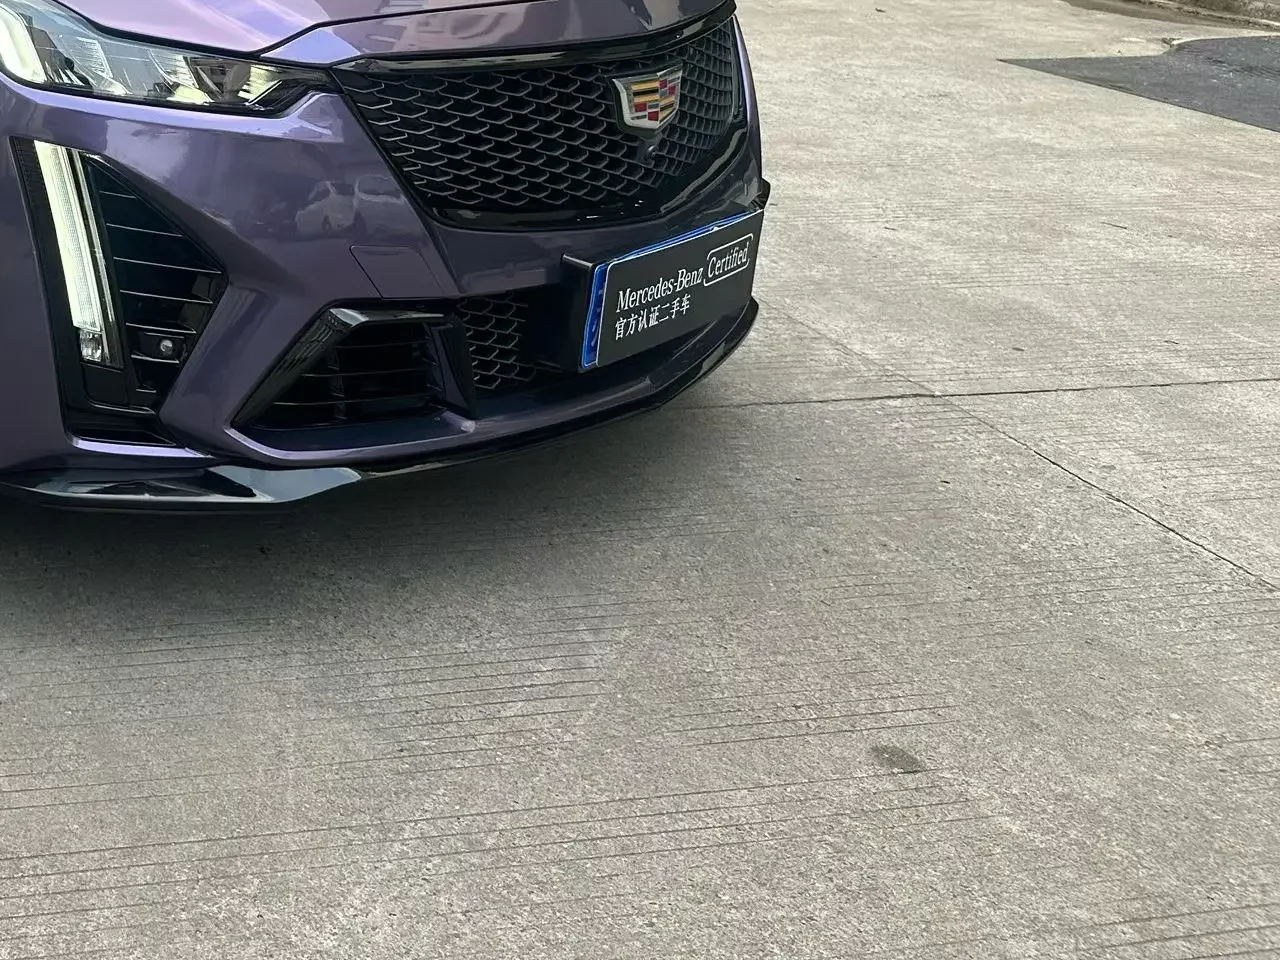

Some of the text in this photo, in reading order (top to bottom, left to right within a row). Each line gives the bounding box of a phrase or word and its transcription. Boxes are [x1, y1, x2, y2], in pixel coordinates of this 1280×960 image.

[616, 241, 749, 313] Mercedes-Benz Certified
[615, 293, 691, 341] 官方认证二手车
